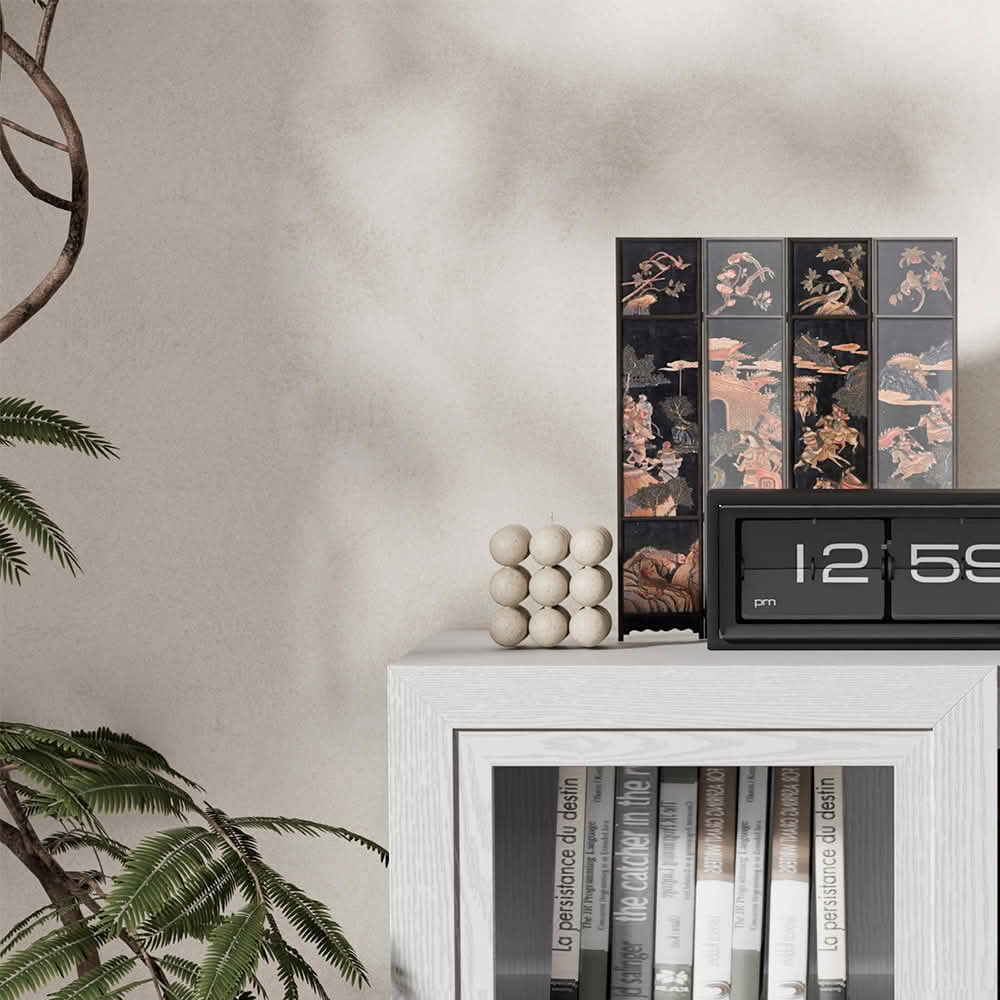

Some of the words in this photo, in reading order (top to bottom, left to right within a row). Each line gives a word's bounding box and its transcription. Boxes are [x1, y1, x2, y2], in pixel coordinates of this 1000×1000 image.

[796, 543, 869, 583] 12
[754, 597, 776, 608] pm
[557, 777, 578, 821] destin
[615, 780, 650, 806] the
[815, 777, 836, 821] destin
[615, 811, 649, 826] in
[555, 826, 577, 845] du
[816, 826, 836, 844] du
[614, 829, 649, 892] catcher
[554, 848, 580, 932] persistance
[818, 848, 845, 932] persistance
[613, 896, 648, 921] the
[552, 936, 572, 952] La
[819, 936, 839, 952] La
[614, 940, 648, 984] salinger
